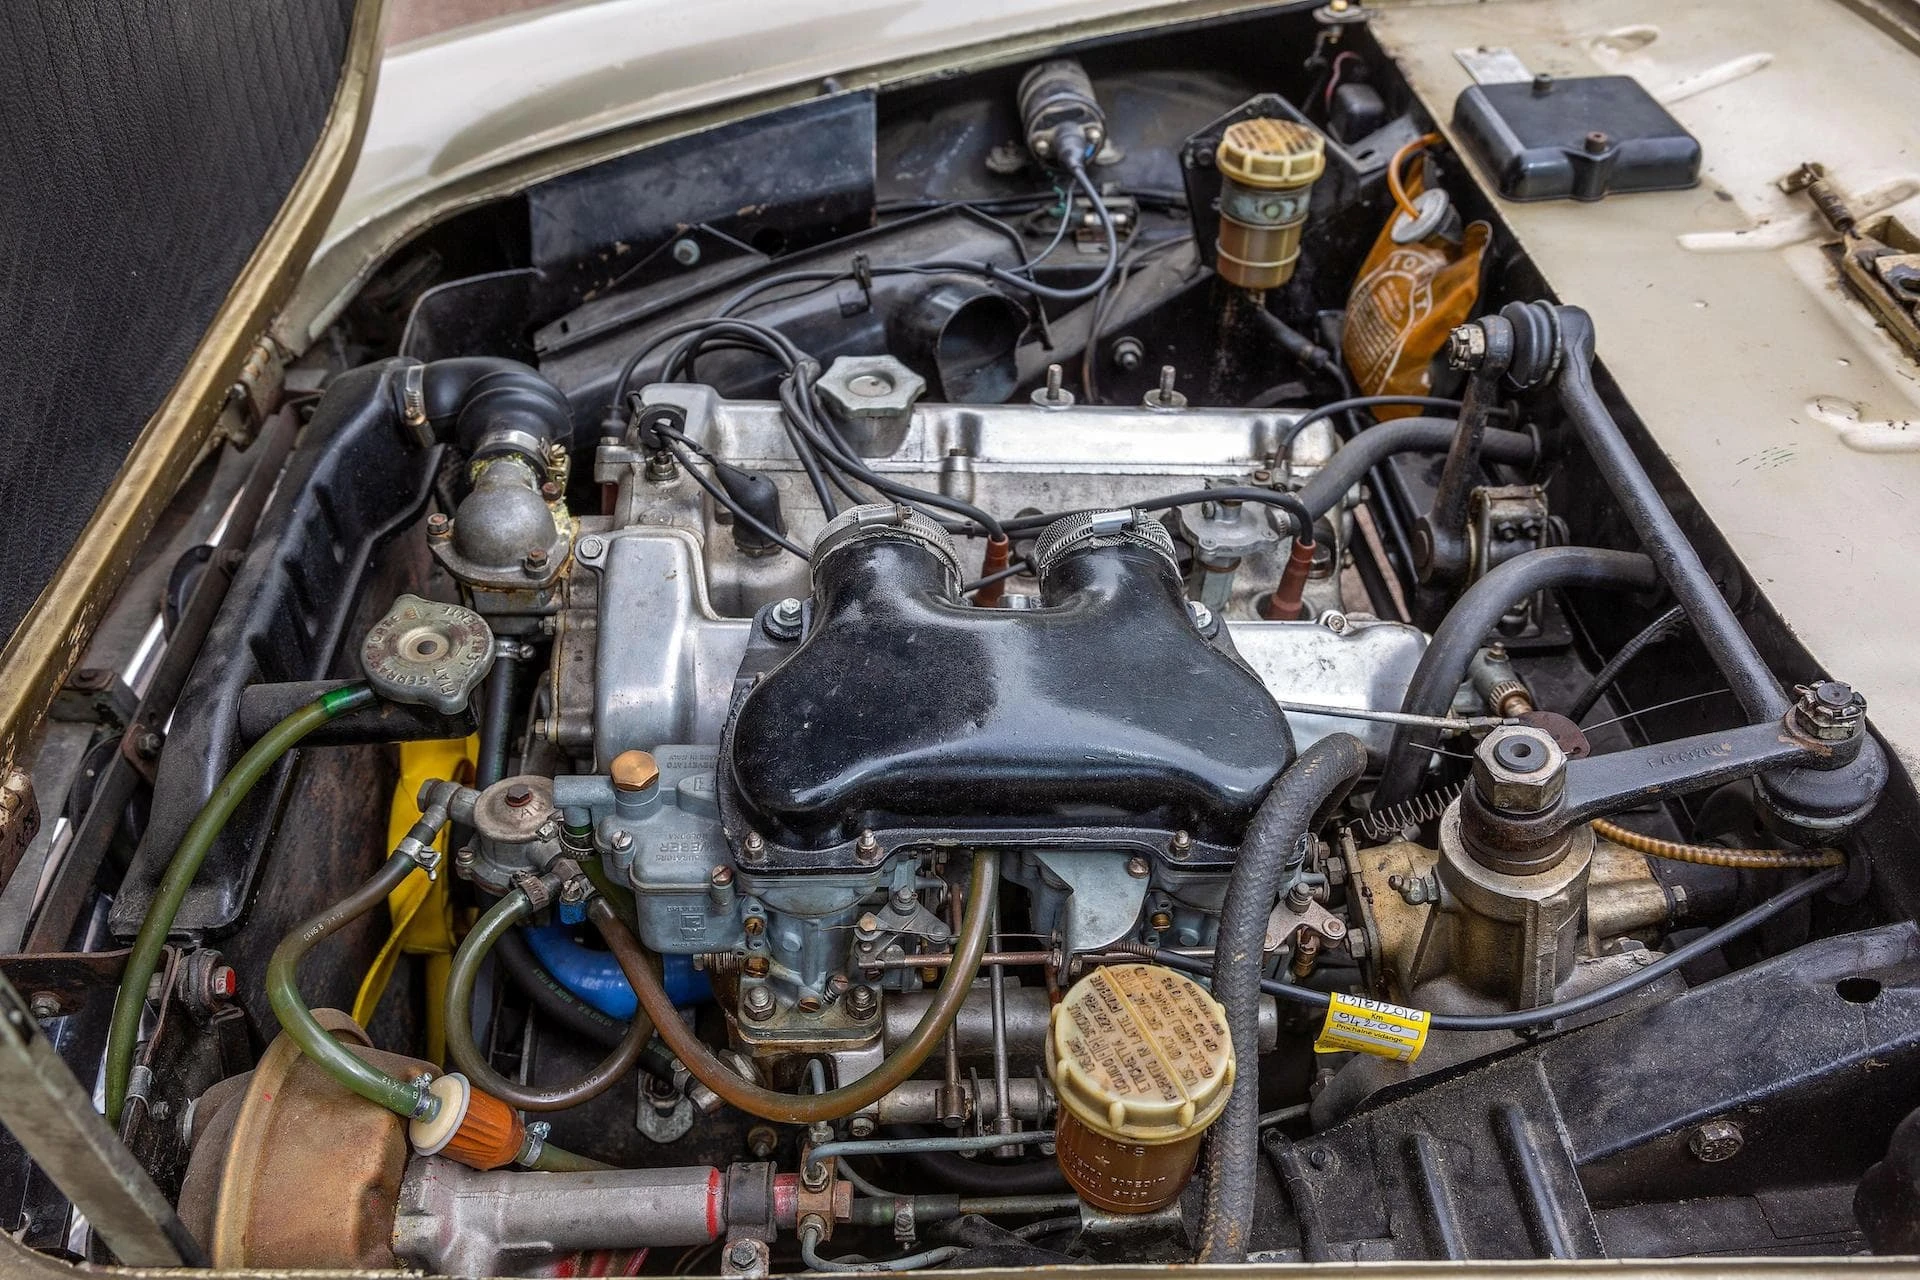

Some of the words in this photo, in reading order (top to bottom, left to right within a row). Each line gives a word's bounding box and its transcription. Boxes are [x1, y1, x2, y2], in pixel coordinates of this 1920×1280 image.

[433, 666, 458, 696] FIAT
[666, 761, 715, 770] REVETTATO
[1066, 1001, 1096, 1038] SPECIALE
[1081, 991, 1116, 1036] AZZURRA
[1132, 992, 1164, 1032] SPECIAL
[1150, 987, 1175, 1018] BRAKE
[1116, 1012, 1143, 1046] LATTE
[1336, 1023, 1372, 1036] Prochaine
[1374, 1030, 1403, 1043] vidange
[1064, 1036, 1096, 1074] USARE
[1136, 1044, 1151, 1058] IN
[1156, 1031, 1183, 1062] ONLY
[1101, 1055, 1132, 1096] LIQUIDO
[1108, 1036, 1153, 1094] ETICHETTA
[1144, 1057, 1179, 1102] FORNITO
[1177, 1062, 1199, 1088] USE
